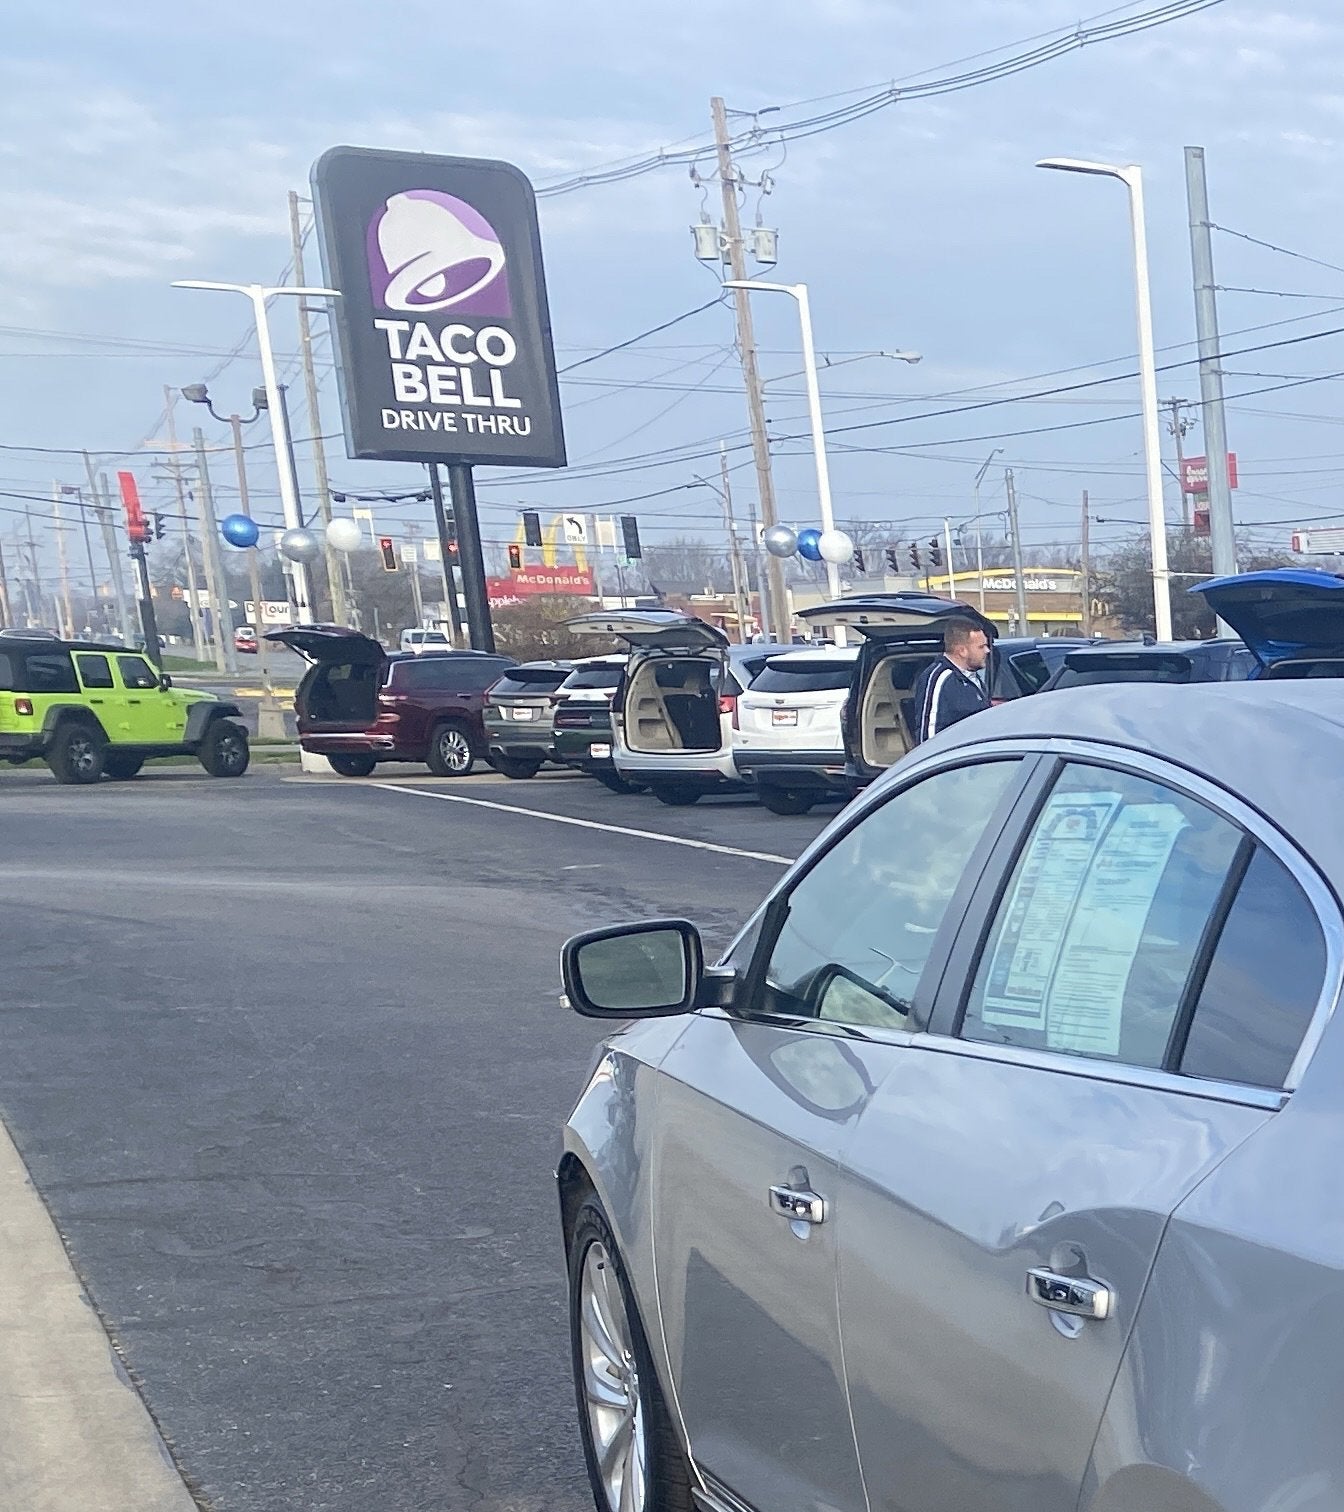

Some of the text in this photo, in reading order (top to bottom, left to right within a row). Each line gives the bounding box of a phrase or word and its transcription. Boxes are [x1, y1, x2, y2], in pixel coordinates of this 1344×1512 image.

[374, 318, 517, 367] TACO
[391, 362, 522, 409] BELL
[381, 408, 531, 436] DRIVE THRU
[566, 534, 587, 543] ONLY
[516, 574, 590, 585] McDonald's
